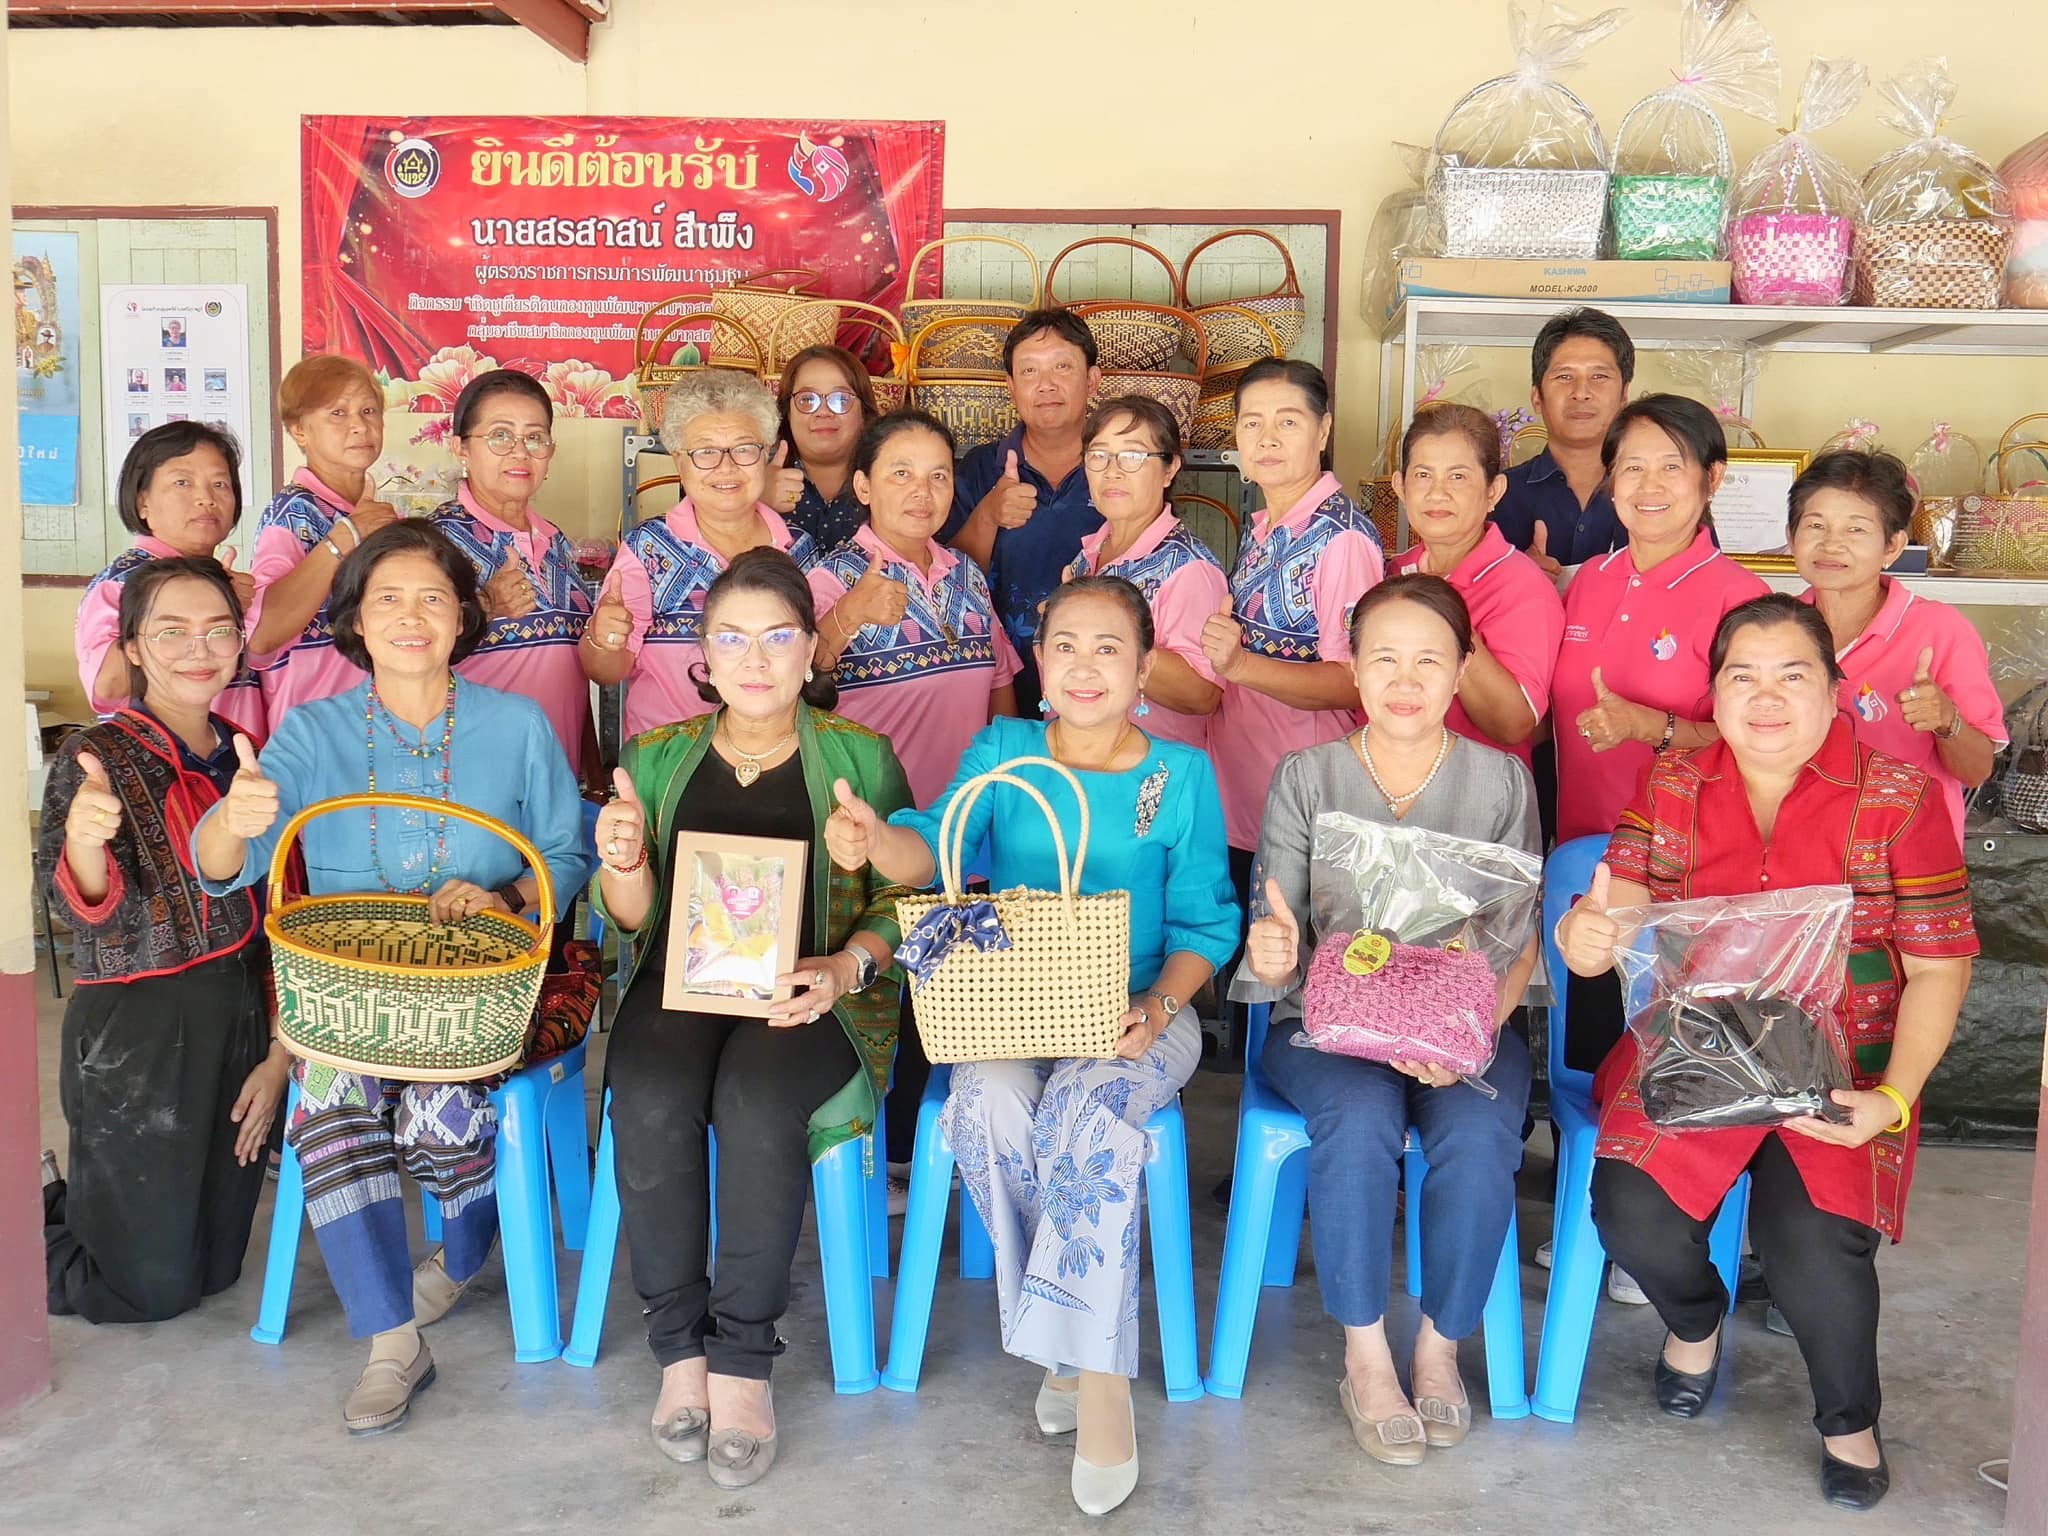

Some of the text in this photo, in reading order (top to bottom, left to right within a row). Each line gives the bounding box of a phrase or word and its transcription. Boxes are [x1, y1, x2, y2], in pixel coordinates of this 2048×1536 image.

[471, 133, 758, 190] ยินดีต้อนรับ
[472, 202, 753, 249] นายสรสาสน์ สีเพ็ง
[1544, 267, 1586, 275] KASHIWA
